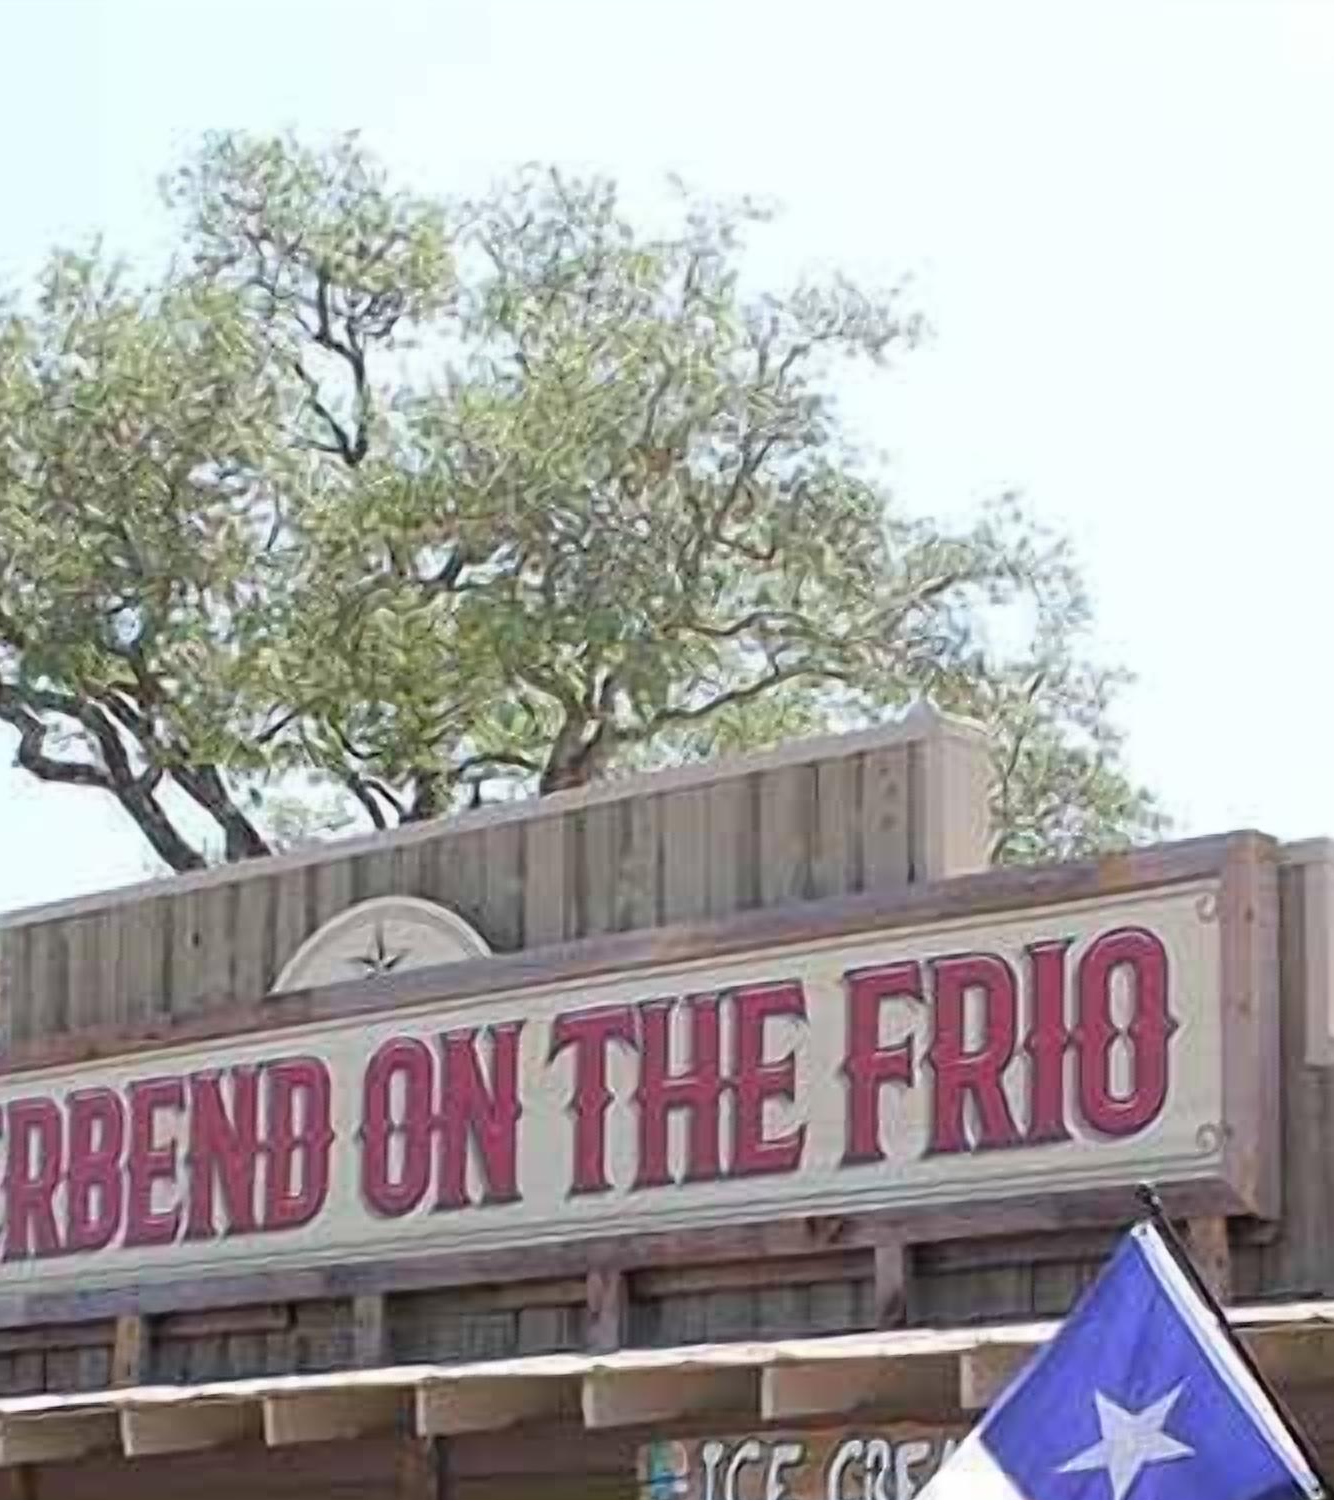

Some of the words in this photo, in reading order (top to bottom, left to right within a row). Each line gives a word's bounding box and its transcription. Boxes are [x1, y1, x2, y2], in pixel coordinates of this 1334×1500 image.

[359, 1021, 524, 1219] ON
[548, 977, 809, 1196] THE
[841, 926, 1179, 1166] FRIO
